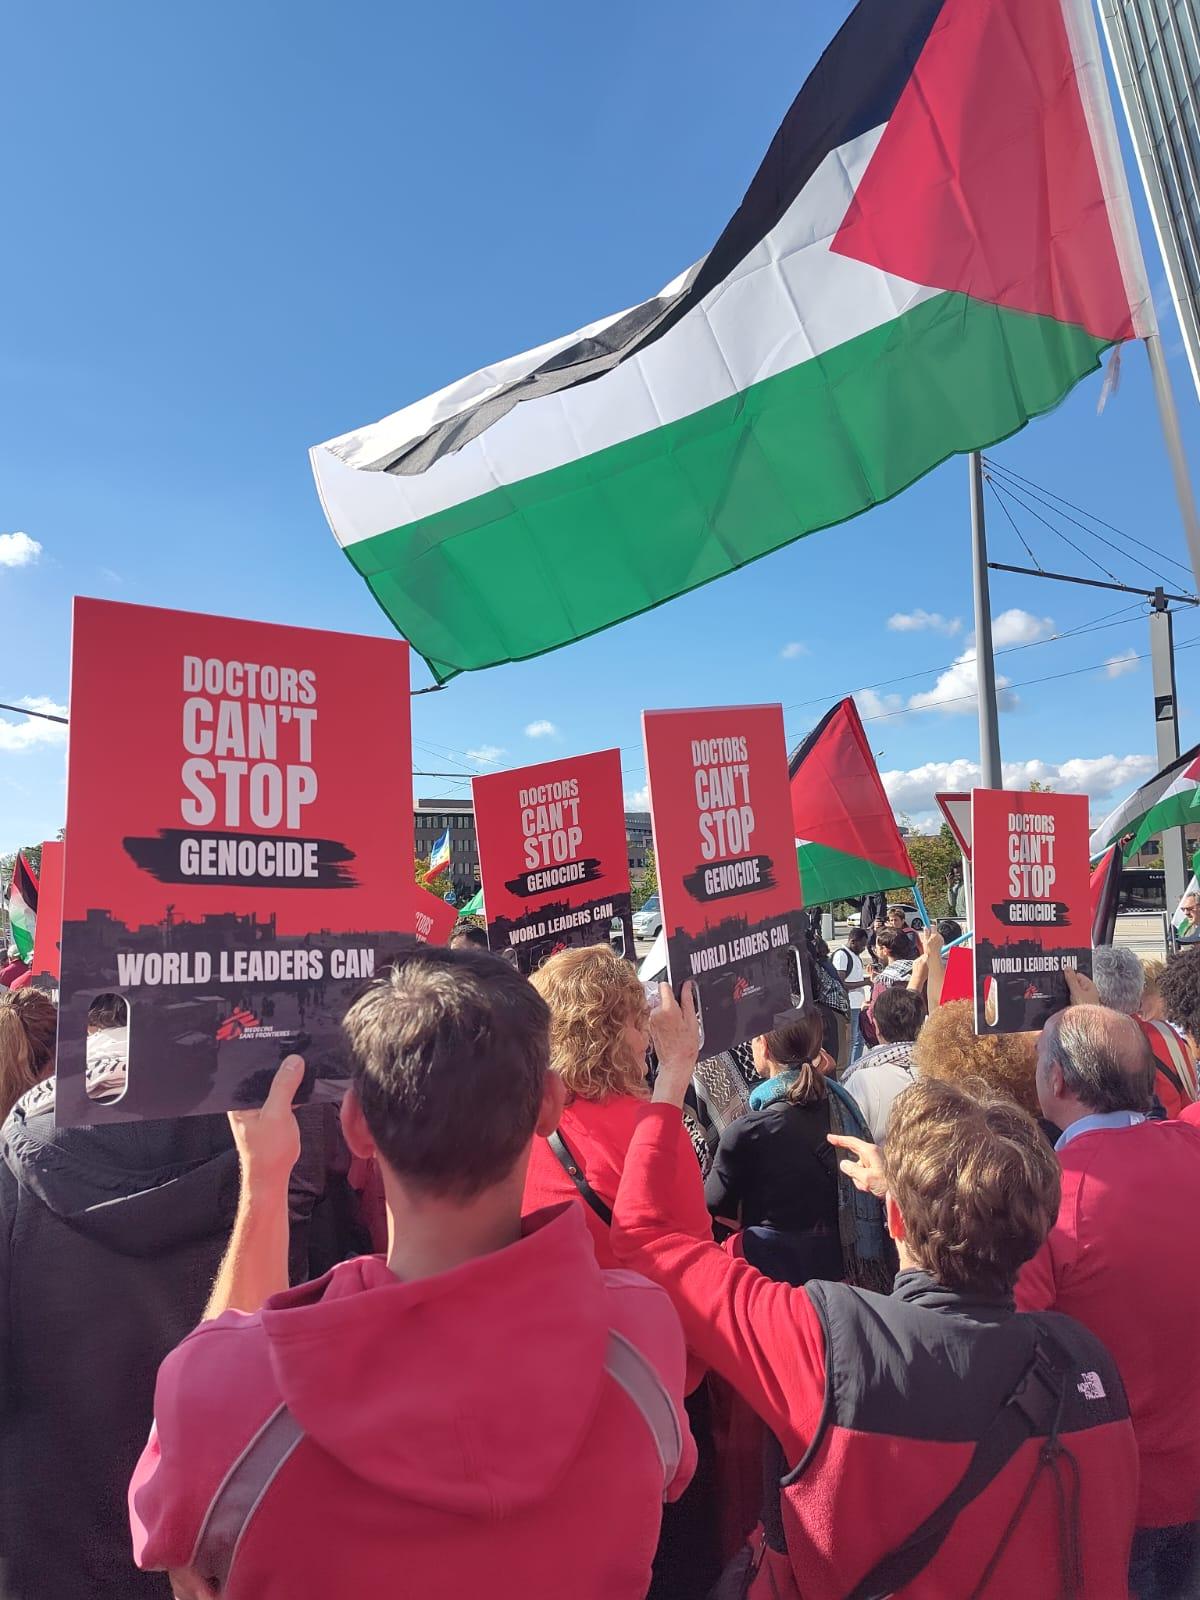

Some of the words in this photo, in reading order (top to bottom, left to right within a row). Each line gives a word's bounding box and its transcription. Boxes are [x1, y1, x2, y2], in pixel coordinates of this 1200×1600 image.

[183, 655, 317, 704] DOCTORS
[182, 697, 317, 763] CAN'T
[691, 736, 748, 766] DOCTORS
[180, 758, 317, 829] STOP
[519, 778, 579, 808] DOCTORS
[695, 764, 749, 811] CAN'T
[521, 797, 580, 837] CAN'T
[699, 805, 755, 860] STOP
[1008, 813, 1055, 833] DOCTORS
[179, 838, 319, 878] GENOCIDE
[523, 826, 583, 870] STOP
[1008, 834, 1056, 864] CAN'T
[527, 862, 585, 892] GENOCIDE
[704, 858, 760, 895] GENOCIDE
[1008, 864, 1056, 898] STOP
[509, 922, 546, 945] WORLD
[547, 910, 592, 935] LEADERS
[593, 903, 613, 920] CAN
[1009, 903, 1057, 922] GENOCIDE
[117, 952, 212, 987] WORLD
[220, 949, 324, 983] LEADERS
[330, 948, 375, 979] CAN
[690, 943, 727, 975] WORLD
[728, 932, 770, 963] LEADERS
[770, 924, 790, 948] CAN
[992, 957, 1022, 973] WORLD
[1023, 956, 1059, 972] LEADERS
[1060, 955, 1078, 971] CAN
